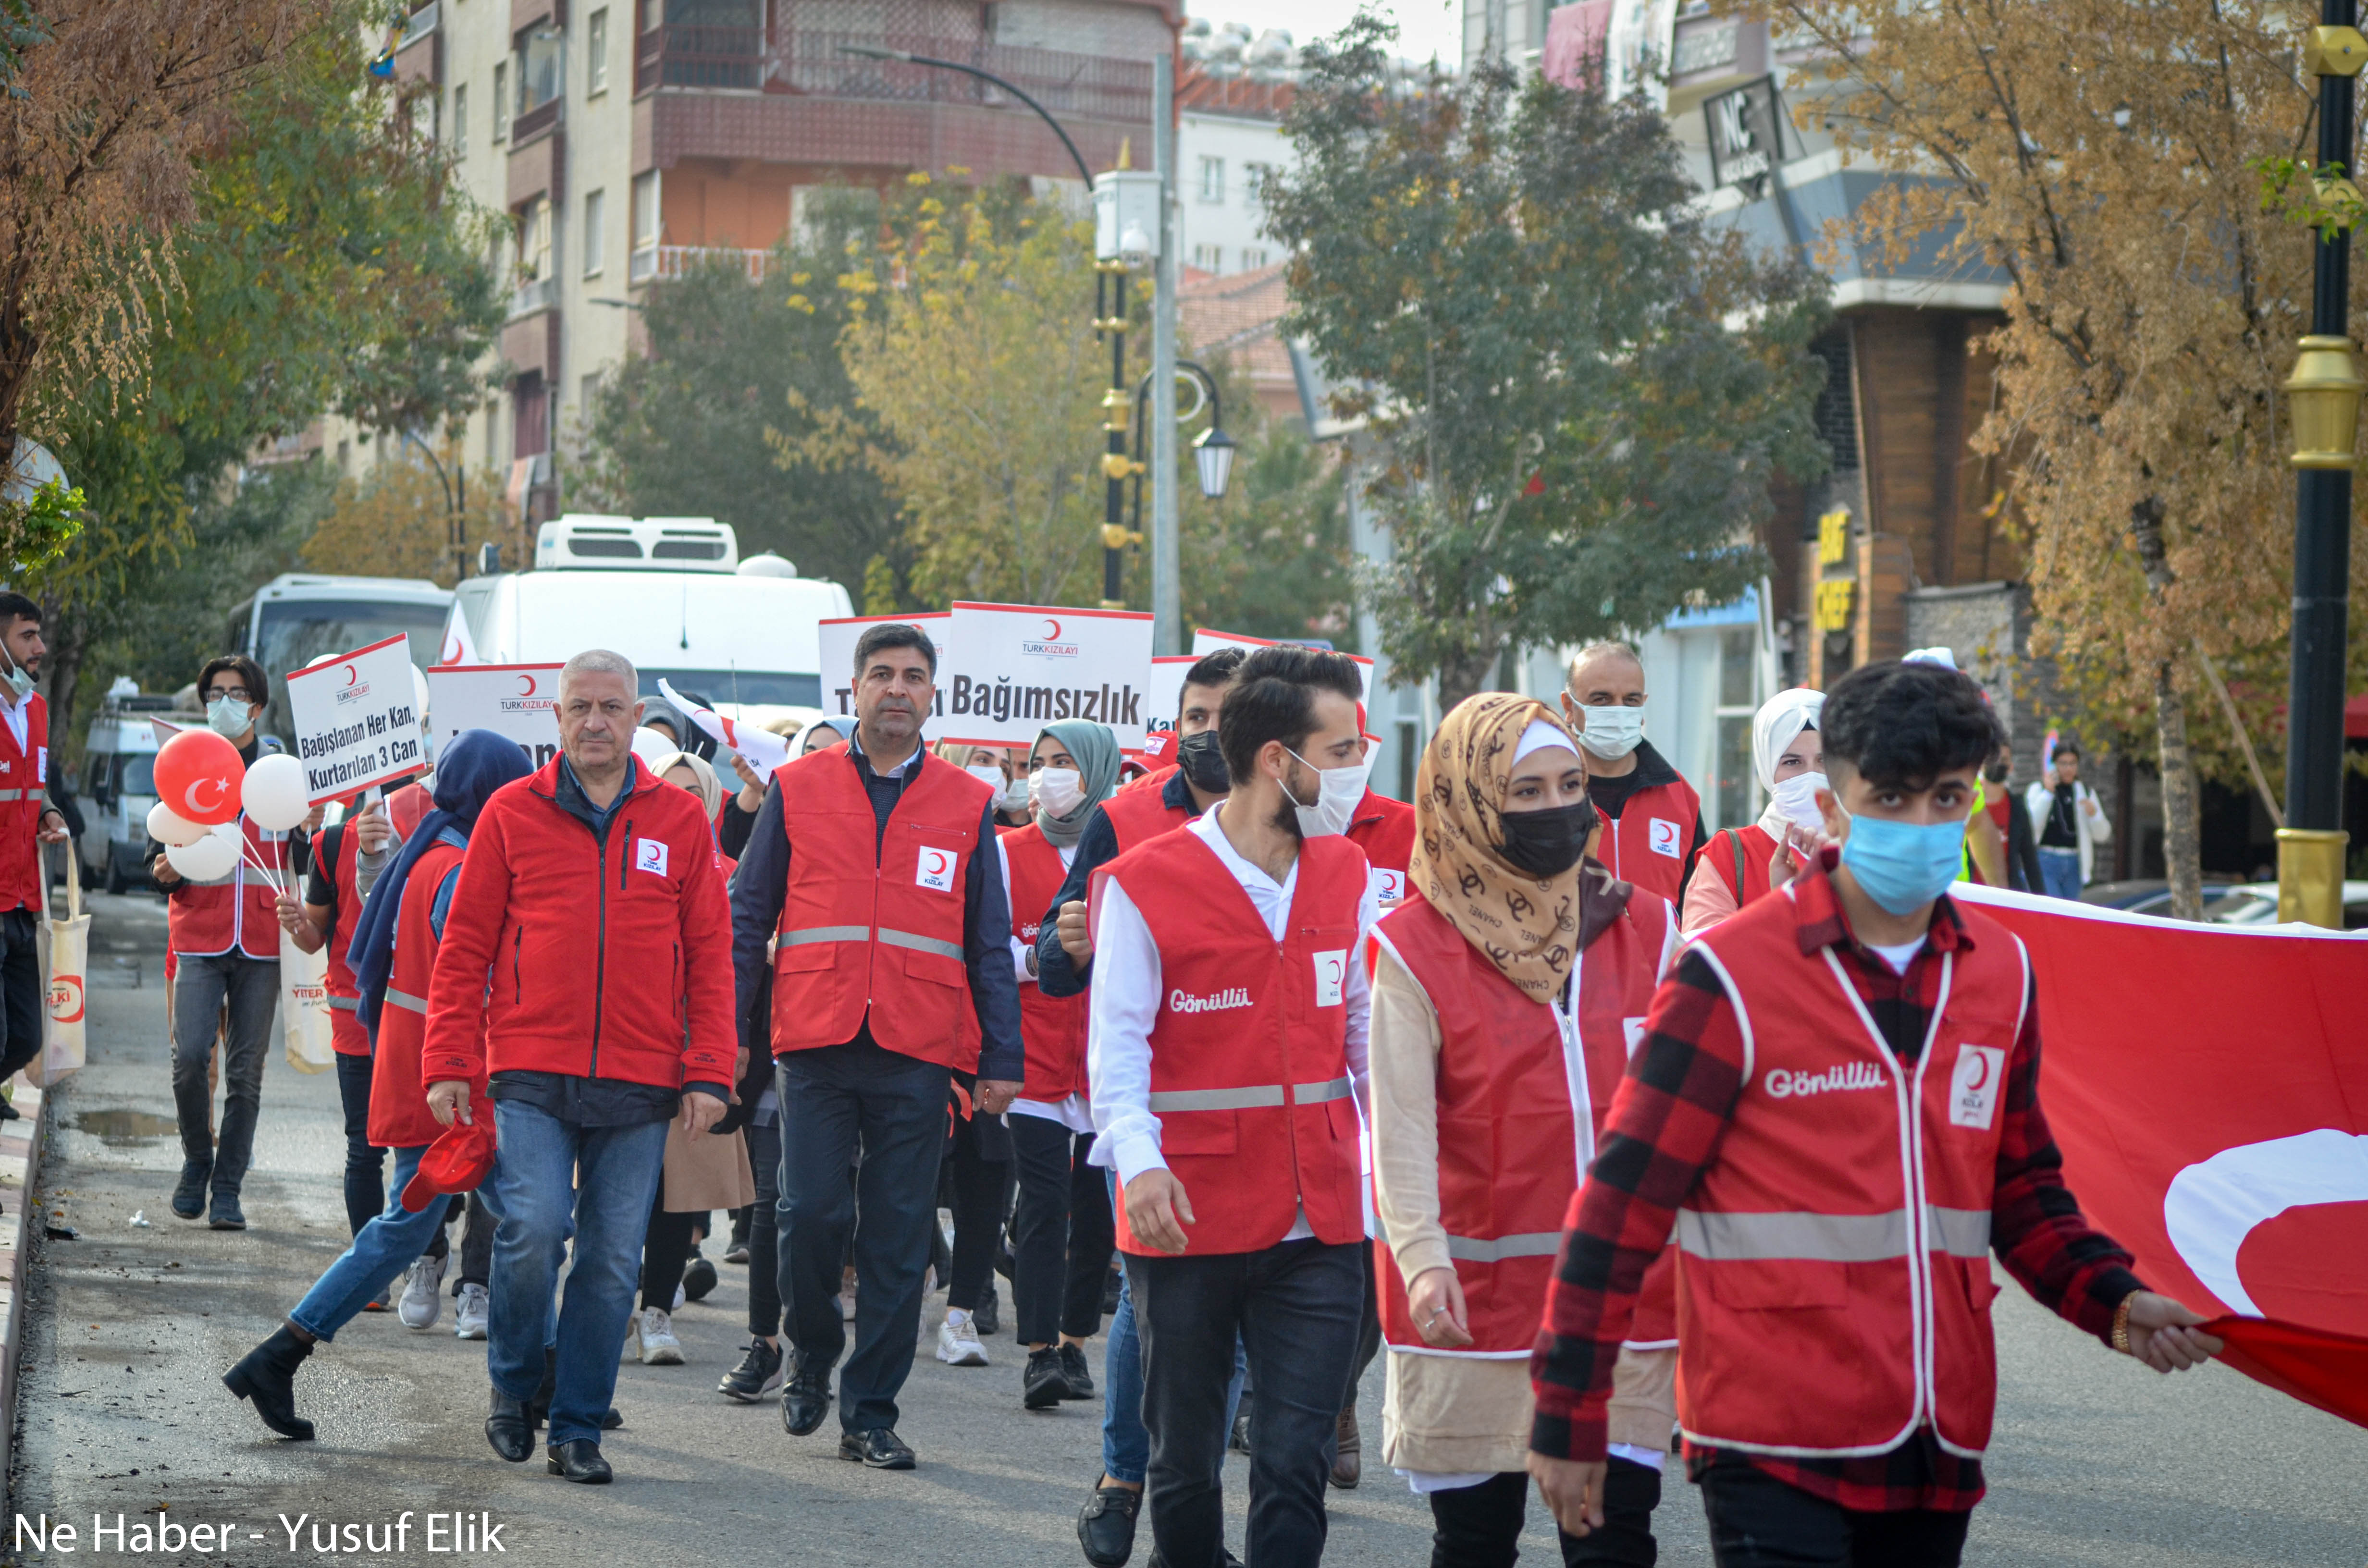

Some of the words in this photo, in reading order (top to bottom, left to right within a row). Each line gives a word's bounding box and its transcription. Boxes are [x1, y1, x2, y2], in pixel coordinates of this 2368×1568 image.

[952, 674, 1141, 725] Bağımsızlık
[301, 722, 365, 759] Bağışlanan
[367, 714, 386, 737] Her
[389, 705, 415, 729] Kan,
[308, 754, 377, 792] Kurtarılan
[379, 746, 388, 768] 3
[392, 738, 418, 763] Can
[925, 878, 944, 886] KIZILAY
[1170, 988, 1254, 1013] Gönüllü
[1764, 1061, 1888, 1098] Gönüllü
